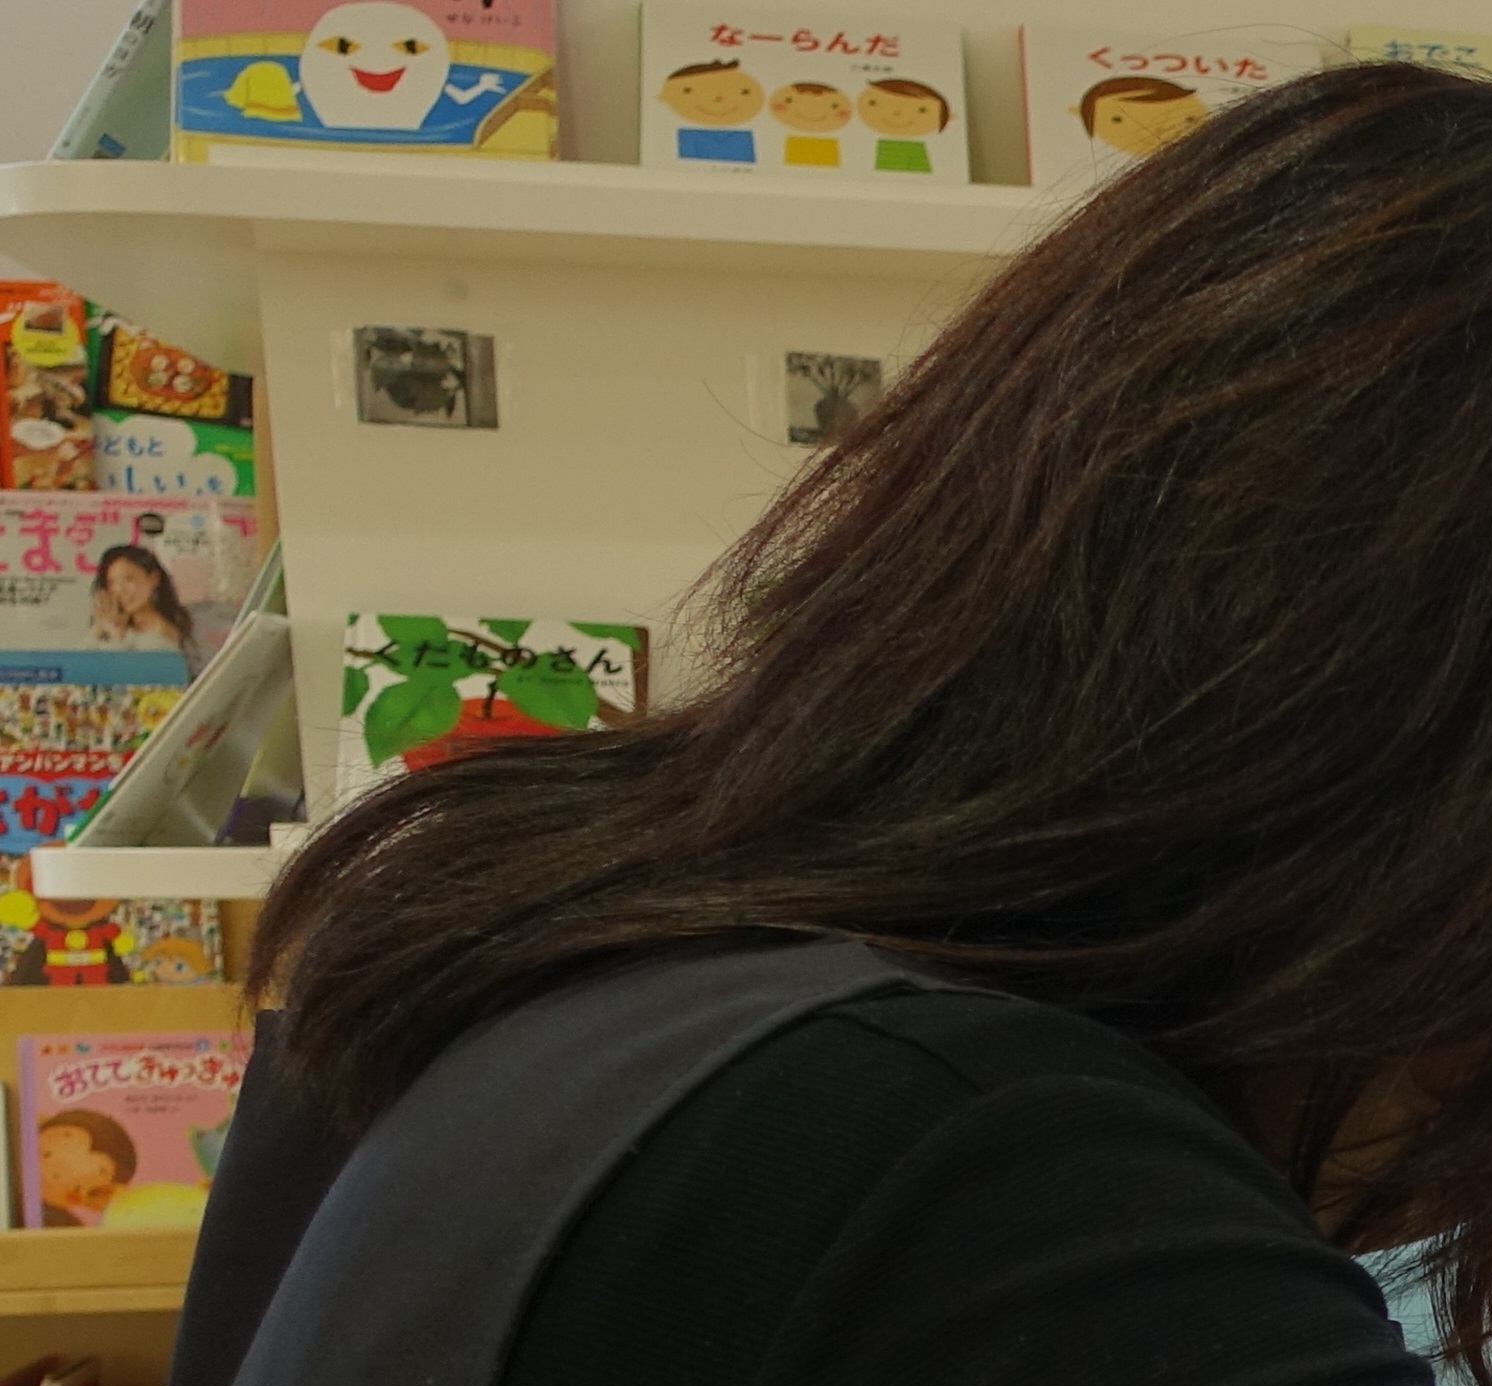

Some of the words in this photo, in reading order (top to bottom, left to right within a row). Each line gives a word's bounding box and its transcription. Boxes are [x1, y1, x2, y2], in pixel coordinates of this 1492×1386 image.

[710, 23, 900, 58] なーらんだ
[1088, 46, 1269, 80] くっついた
[374, 640, 622, 674] くだものさん
